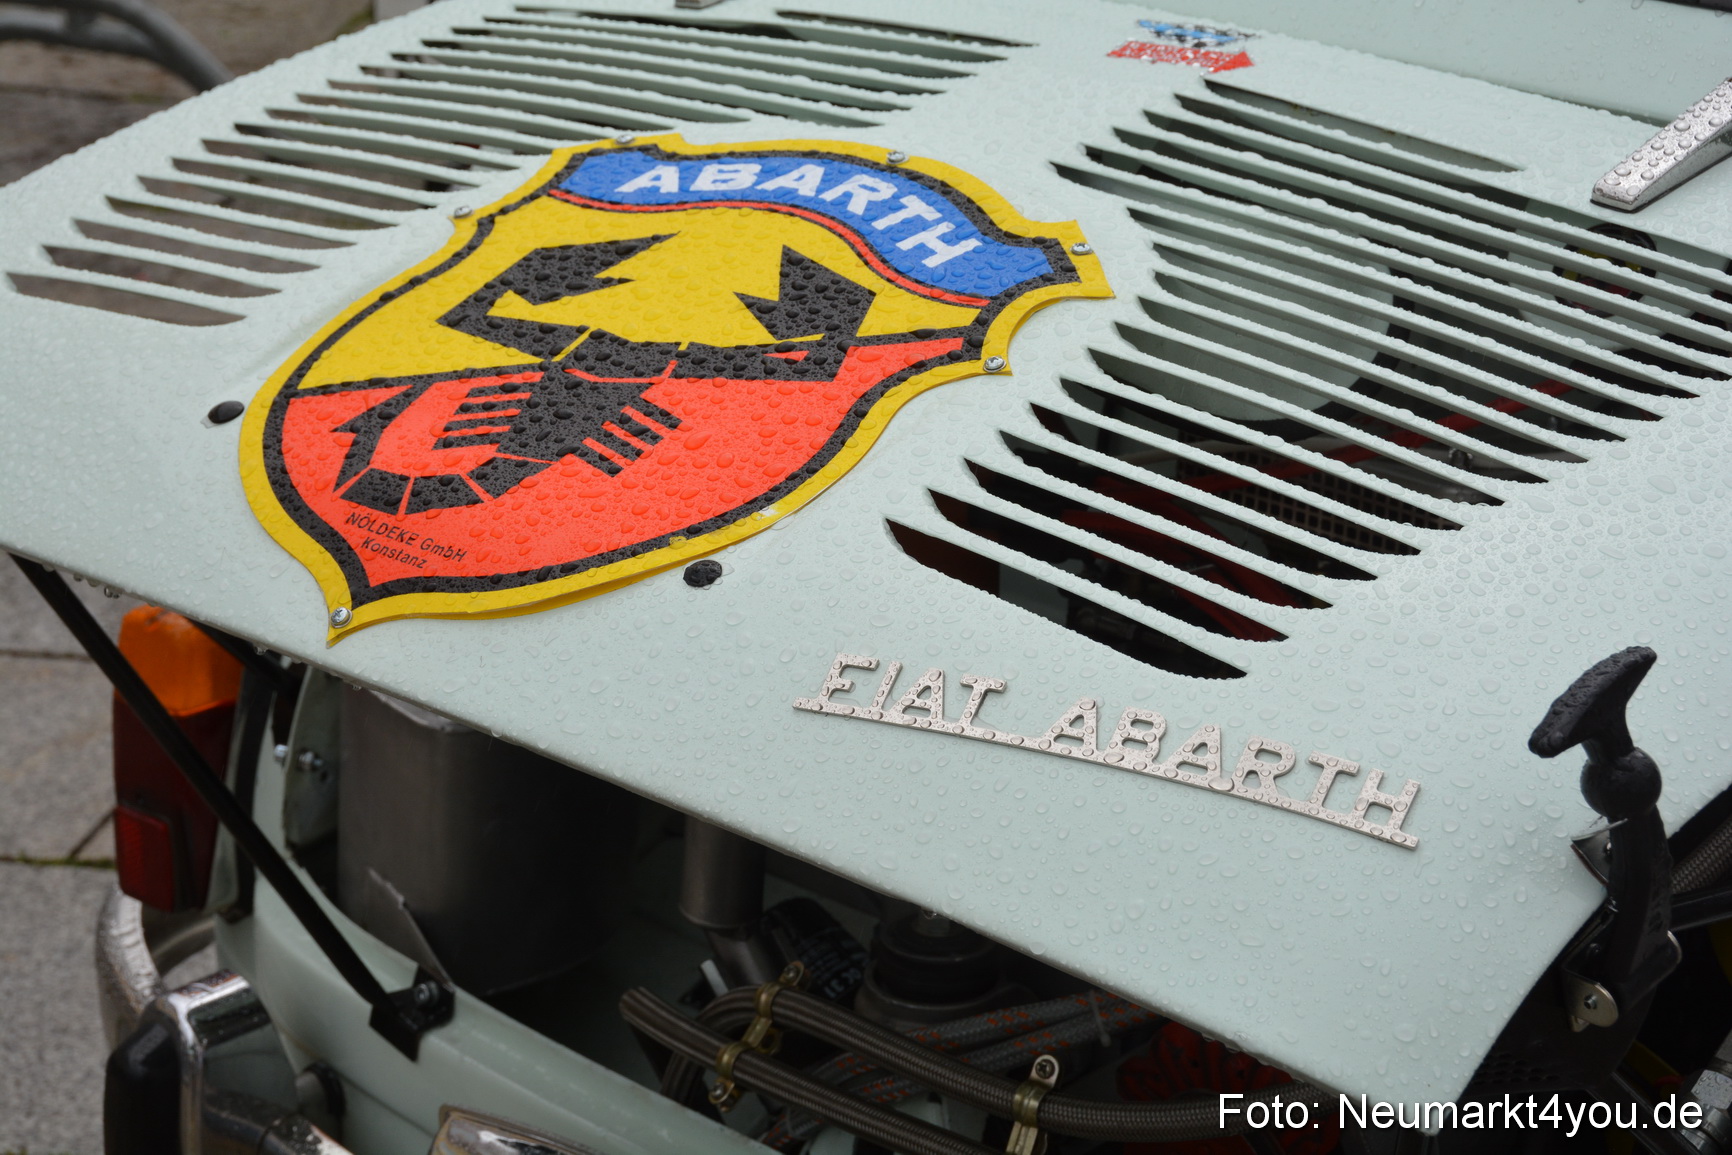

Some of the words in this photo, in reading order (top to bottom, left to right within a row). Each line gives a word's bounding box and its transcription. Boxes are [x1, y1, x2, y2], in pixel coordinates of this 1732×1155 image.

[614, 162, 984, 269] ABARTH
[345, 512, 420, 546] NÖLDEKE
[420, 537, 468, 562] GmbH
[360, 536, 428, 569] Konstanz
[793, 652, 1008, 738] FIAT
[1032, 696, 1421, 851] ABARTH
